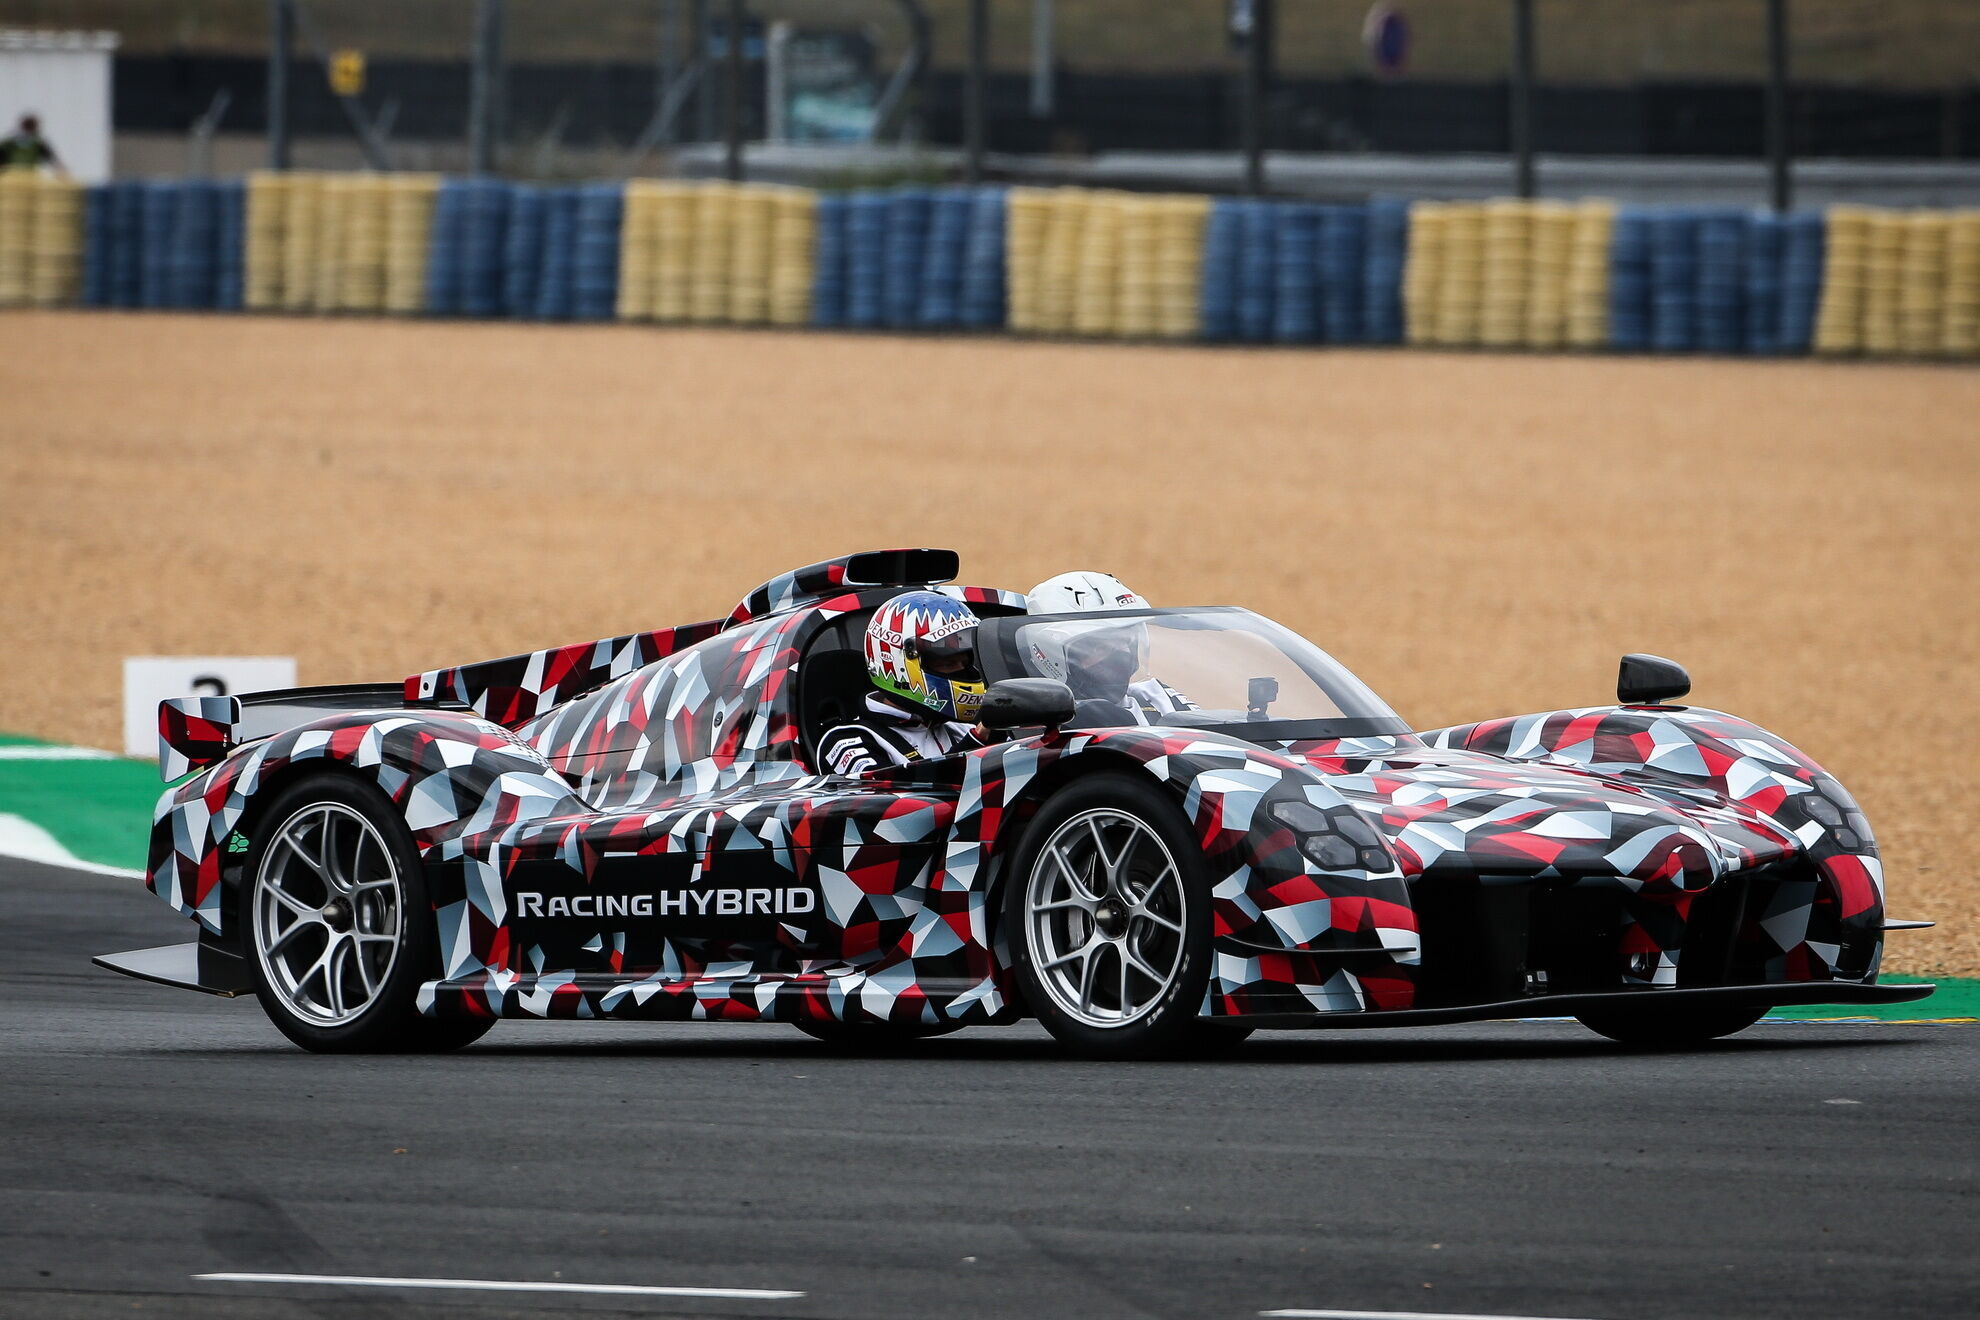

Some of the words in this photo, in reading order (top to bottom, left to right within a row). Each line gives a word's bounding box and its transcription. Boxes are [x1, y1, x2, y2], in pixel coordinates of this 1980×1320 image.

[868, 620, 902, 645] DENSO
[930, 620, 971, 640] TOYOTA
[957, 694, 984, 705] DEN
[841, 750, 857, 768] ZENT
[660, 887, 815, 916] HYBRID
